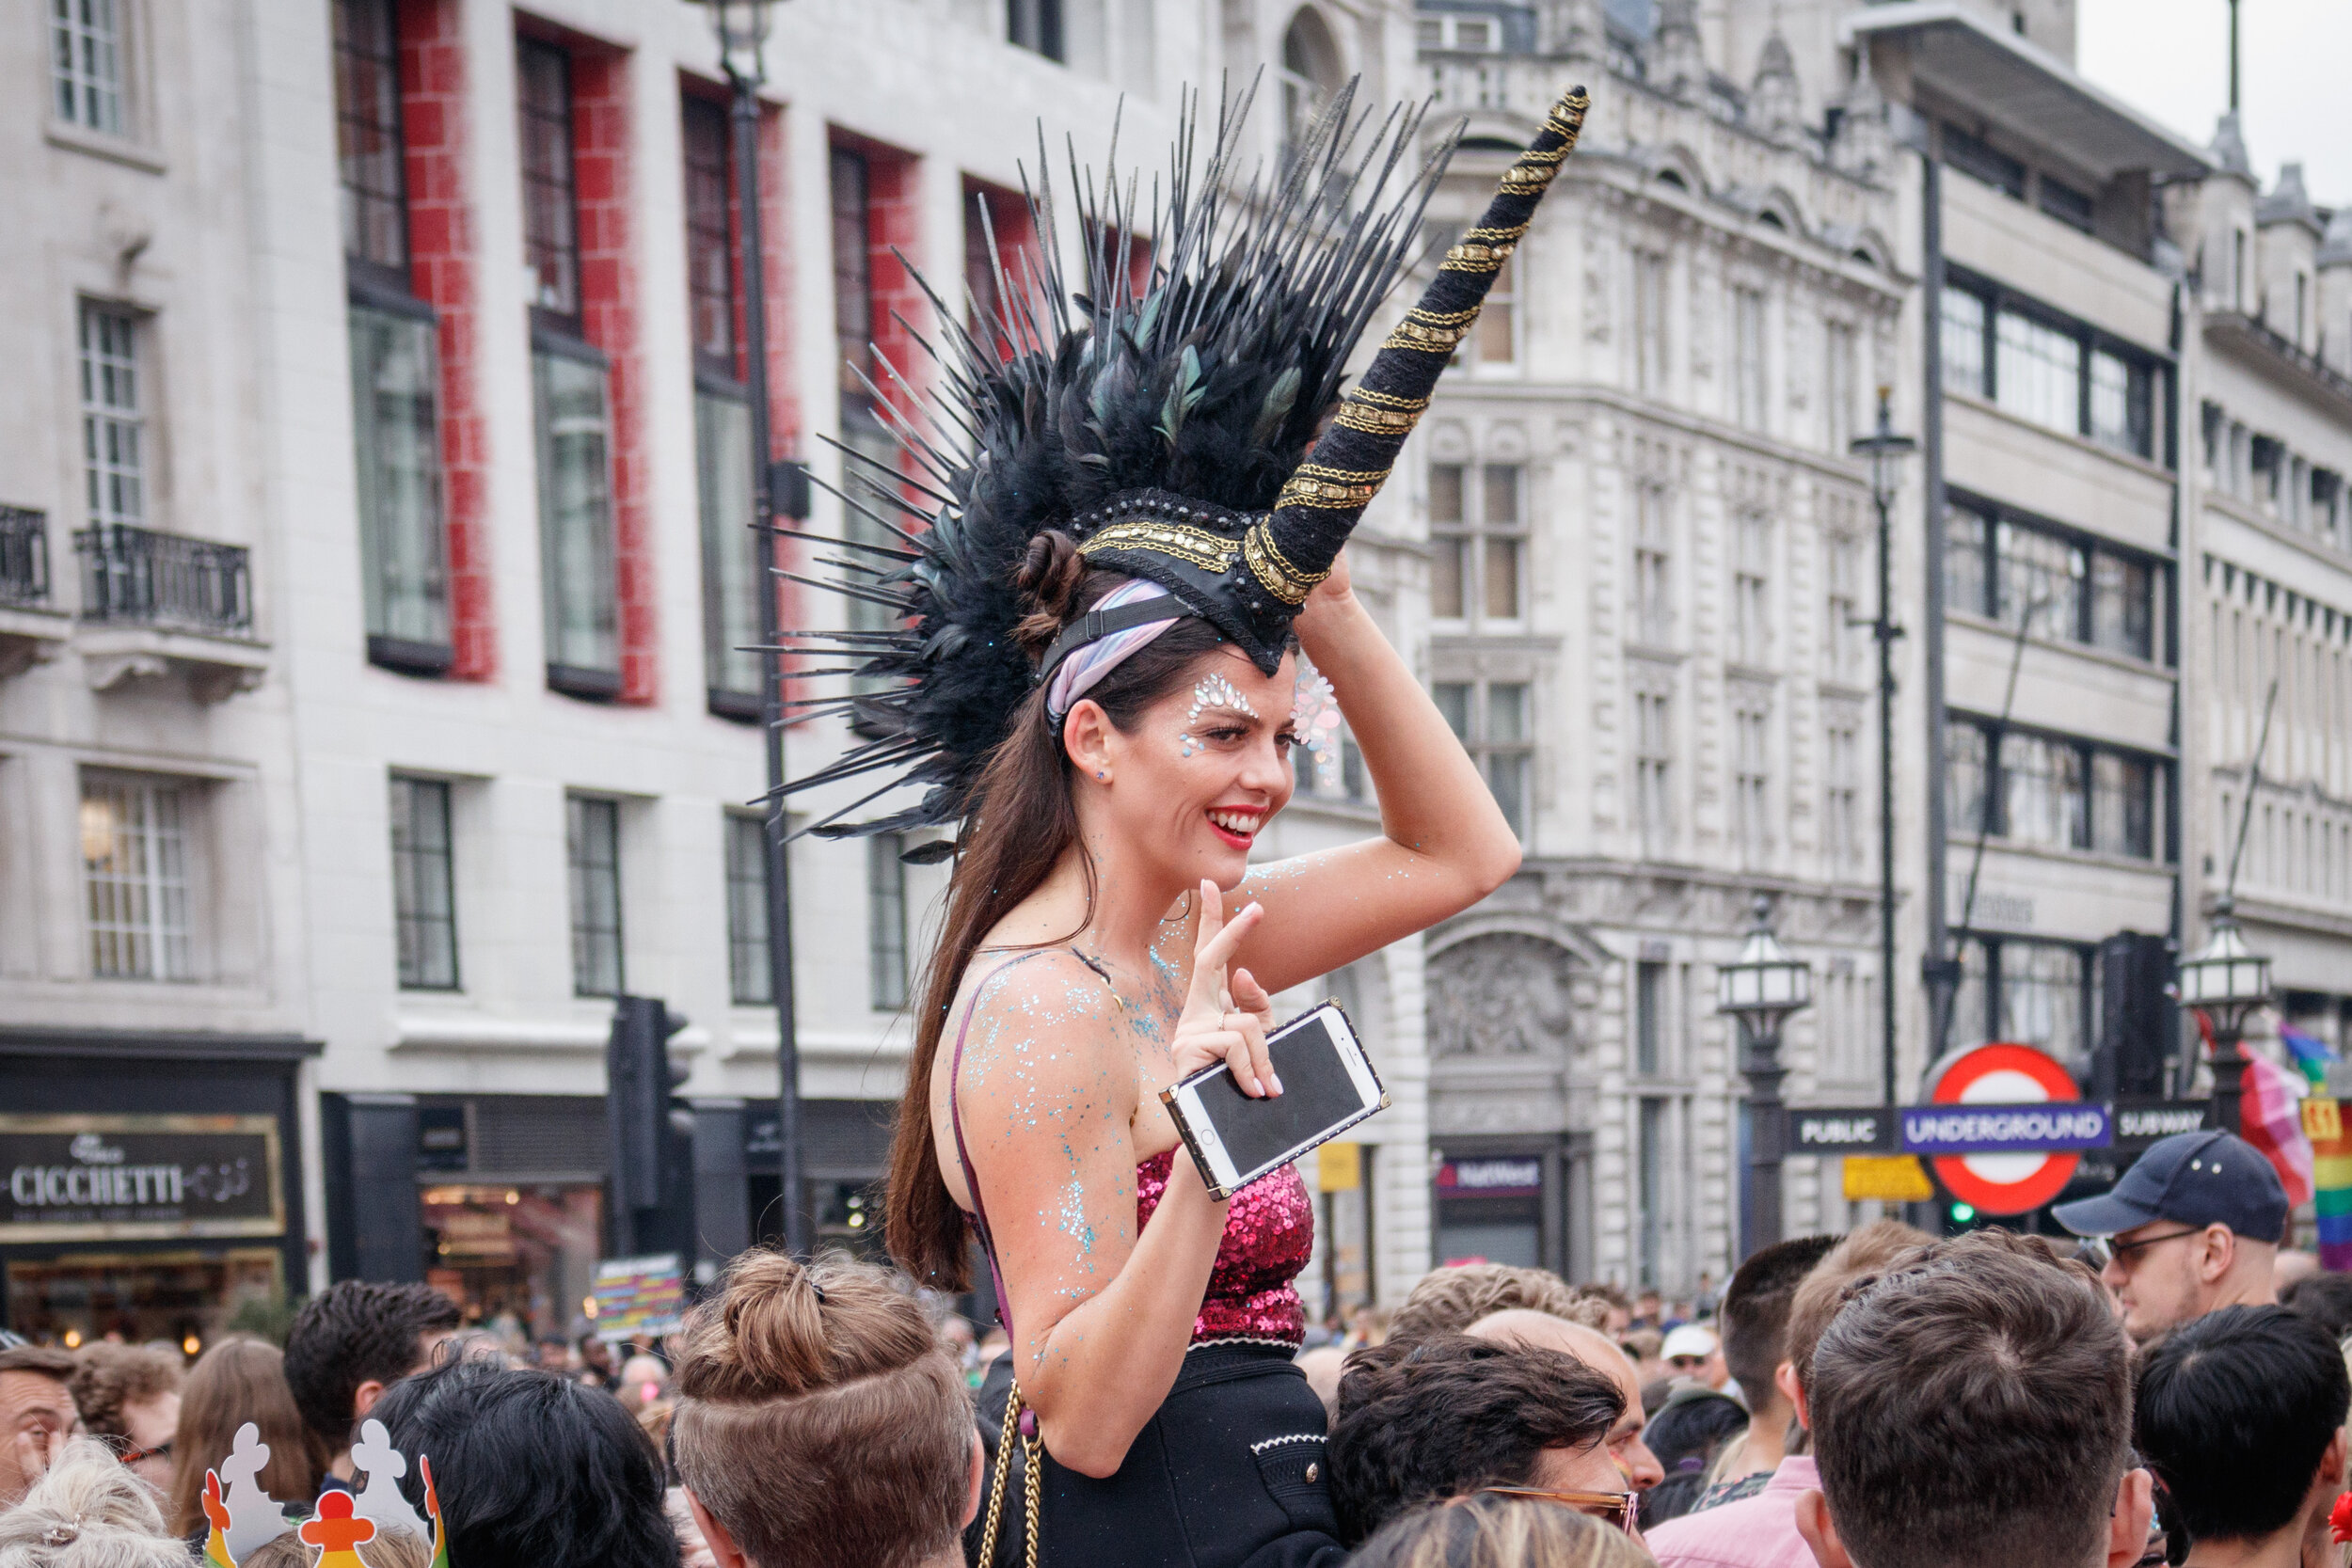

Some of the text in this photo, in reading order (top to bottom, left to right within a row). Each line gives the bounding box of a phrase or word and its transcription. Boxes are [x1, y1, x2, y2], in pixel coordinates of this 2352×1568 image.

[1801, 1111, 2205, 1144] PUBLIC UNDERGROUND SUBWAY
[11, 1164, 183, 1205] CICCHETTI
